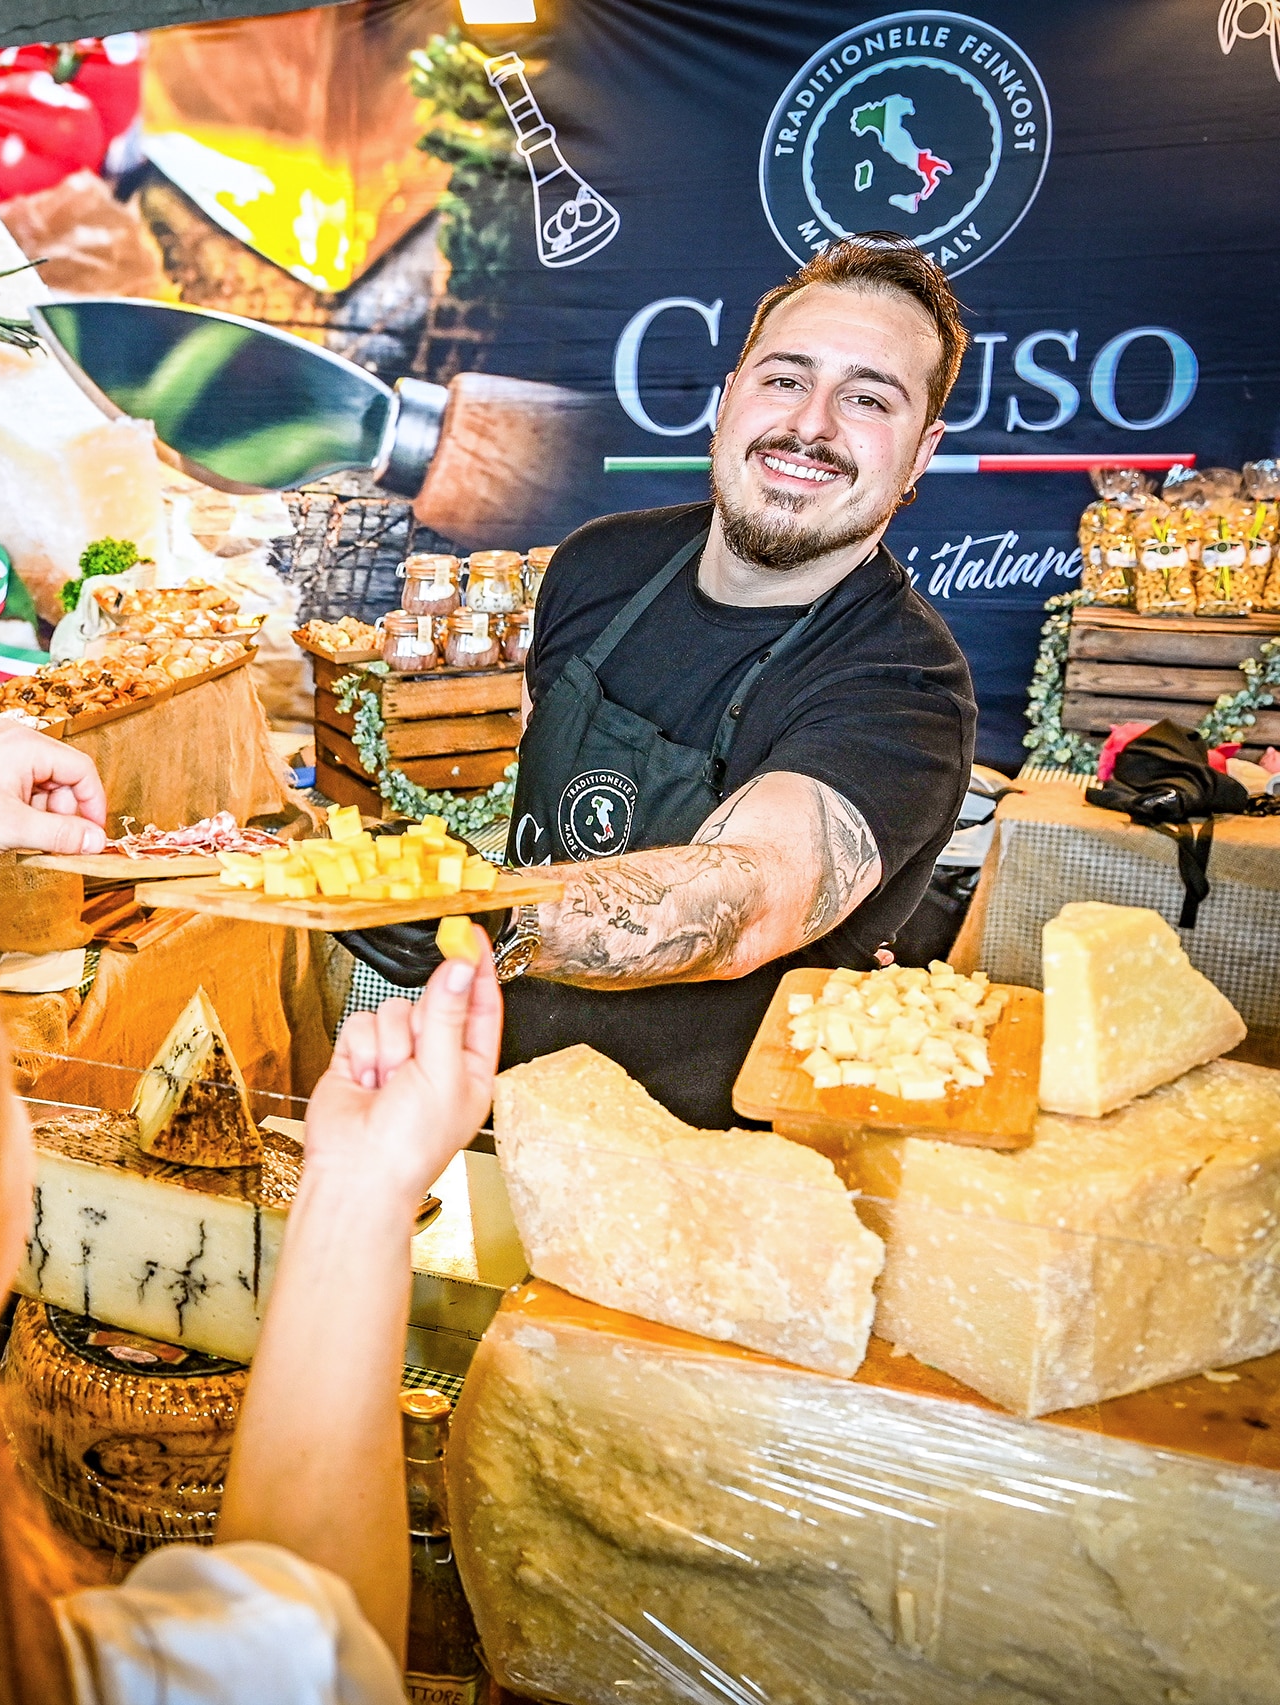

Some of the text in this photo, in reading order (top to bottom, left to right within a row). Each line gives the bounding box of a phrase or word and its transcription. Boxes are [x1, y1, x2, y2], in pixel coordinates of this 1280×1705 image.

[775, 25, 1036, 157] TRADITIONELLE FEINKOST
[797, 219, 830, 255] MA
[613, 297, 1200, 437] CUSO
[566, 774, 632, 800] TRADITIONELLE
[564, 823, 589, 863] MADE IN
[407, 1685, 465, 1705] TTORE
